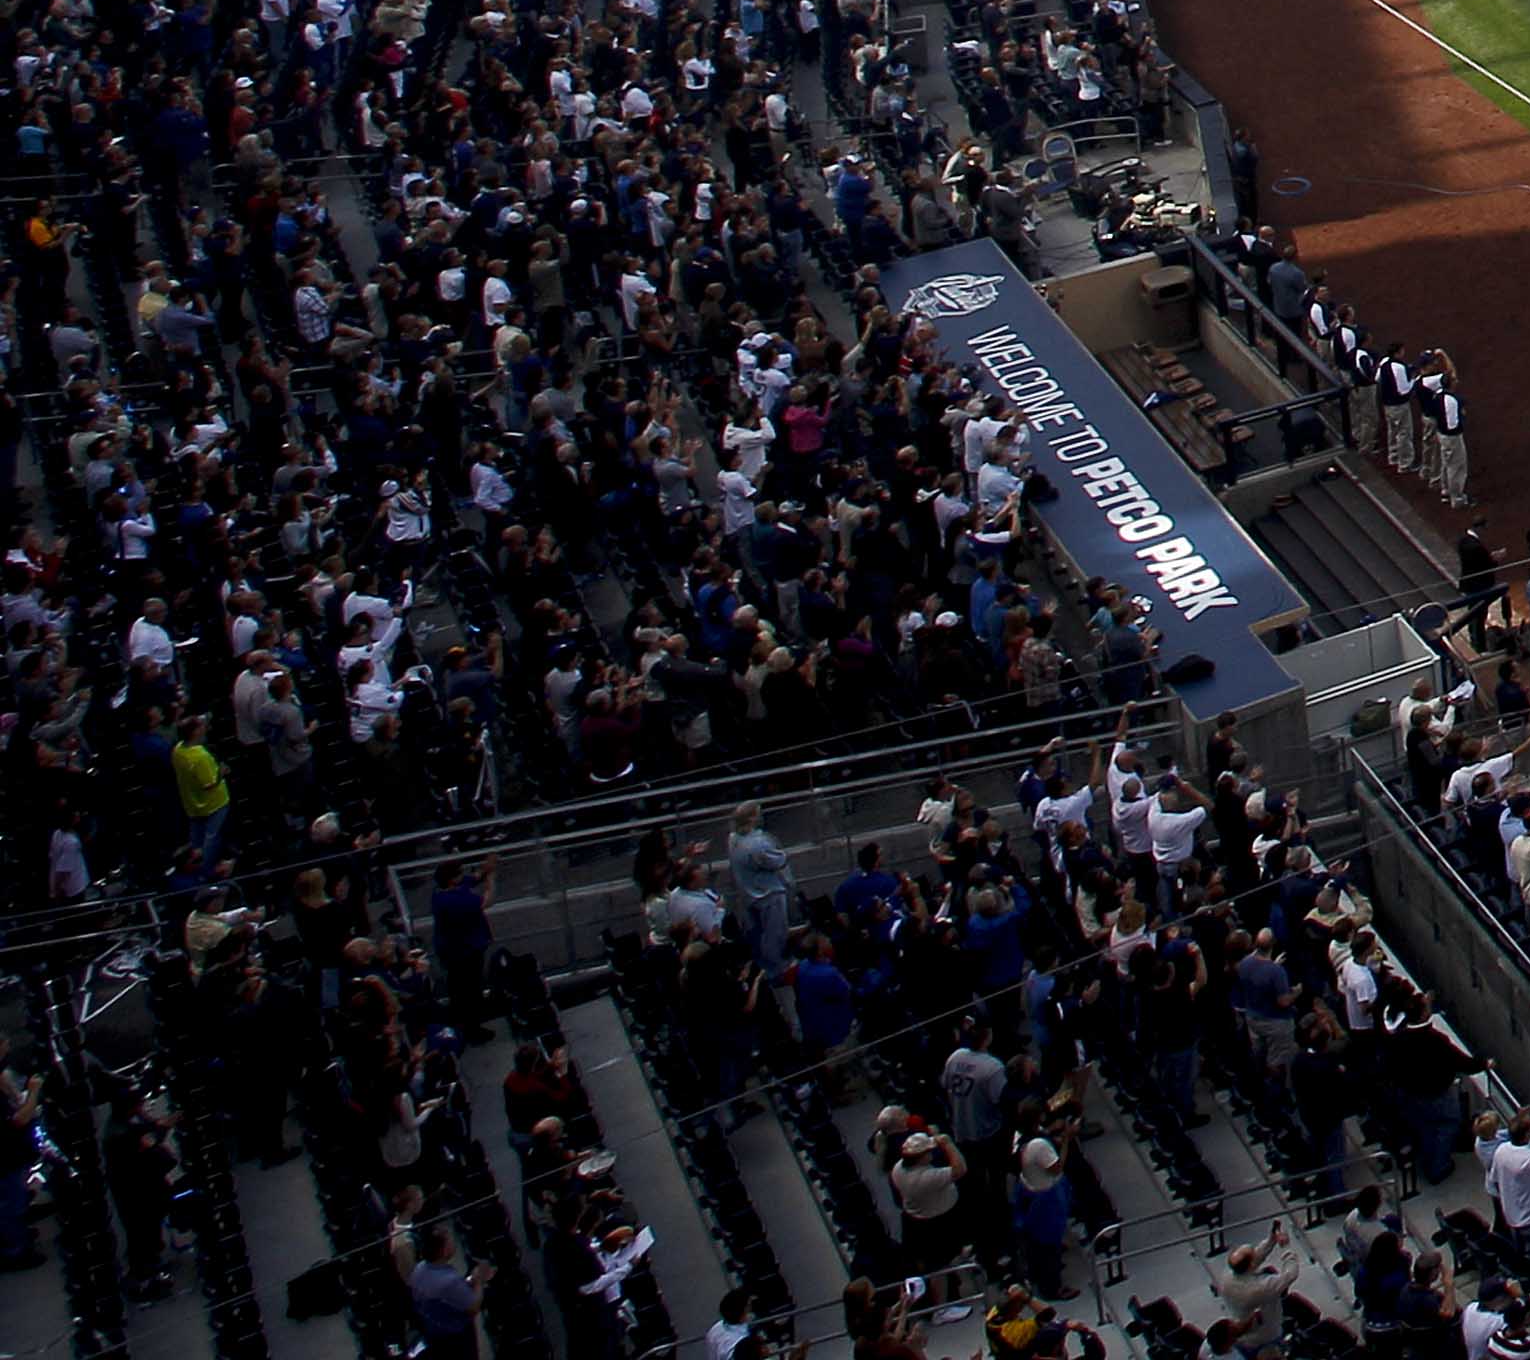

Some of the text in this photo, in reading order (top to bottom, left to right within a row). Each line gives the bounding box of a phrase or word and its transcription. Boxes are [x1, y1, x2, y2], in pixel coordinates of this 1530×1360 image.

[966, 323, 1240, 623] WELCOME TO PETCO PARK
